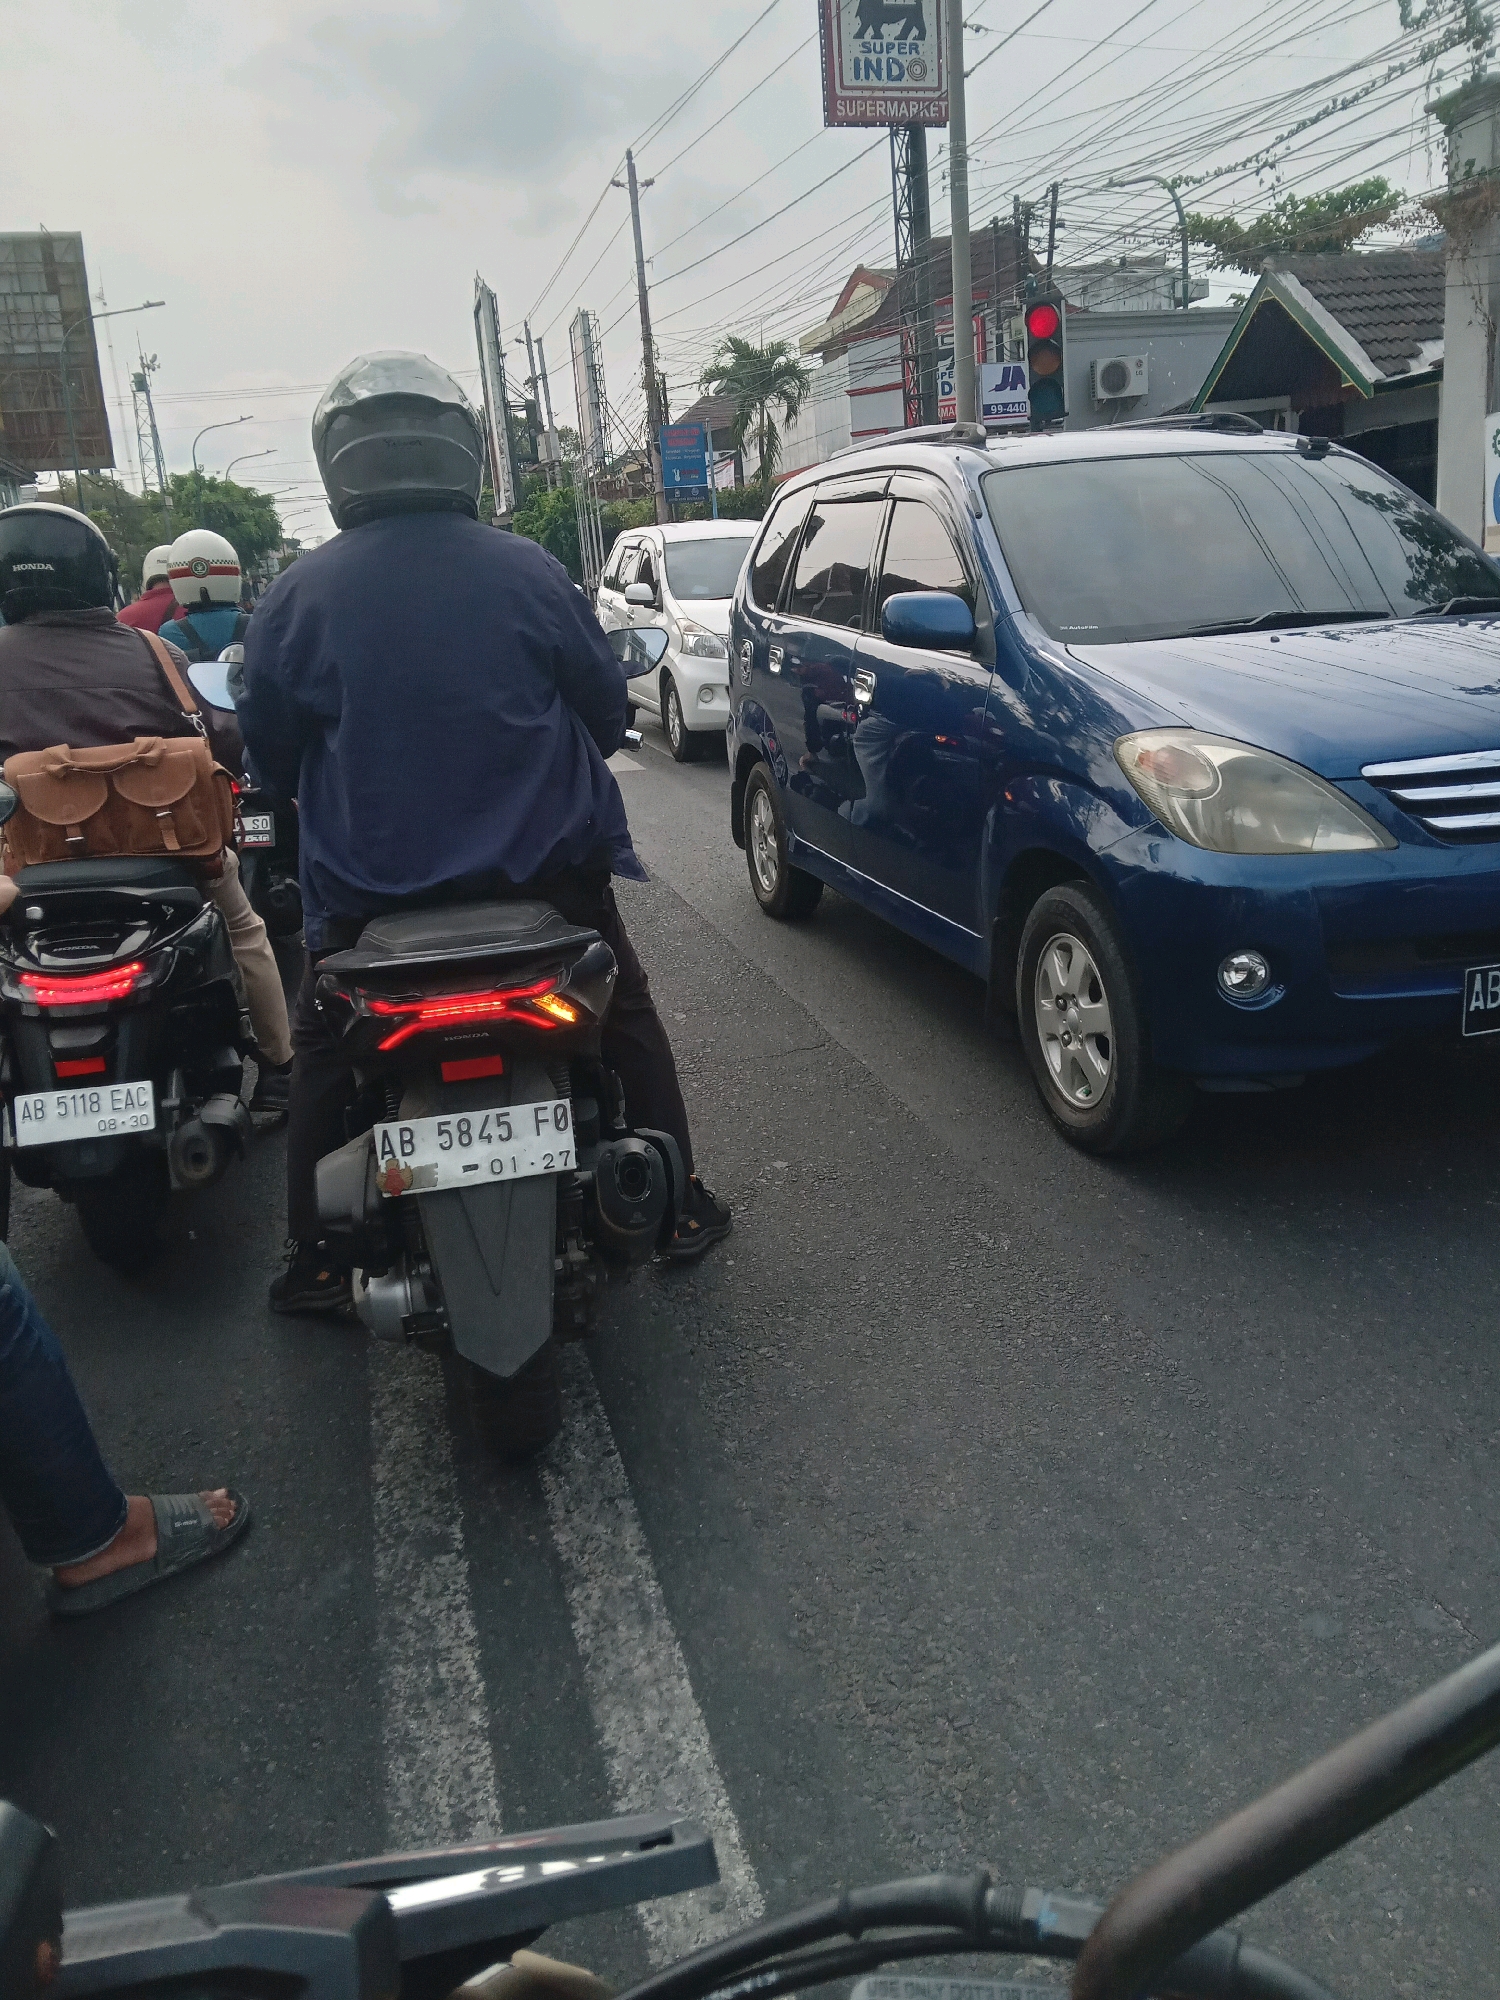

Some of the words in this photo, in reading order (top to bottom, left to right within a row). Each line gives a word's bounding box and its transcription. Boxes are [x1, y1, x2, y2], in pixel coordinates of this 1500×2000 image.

[861, 41, 920, 55] SUPER
[853, 57, 927, 81] INDO
[836, 100, 948, 118] SUPERMARKET
[12, 563, 54, 572] HONDA
[52, 944, 100, 953] HONDA
[1469, 971, 1500, 1011] AB
[444, 1032, 490, 1042] HONDA
[21, 1098, 45, 1122] AB
[57, 1092, 101, 1117] 5118
[111, 1086, 148, 1111] EAC
[380, 1126, 415, 1160] AB
[437, 1111, 513, 1151] 5845
